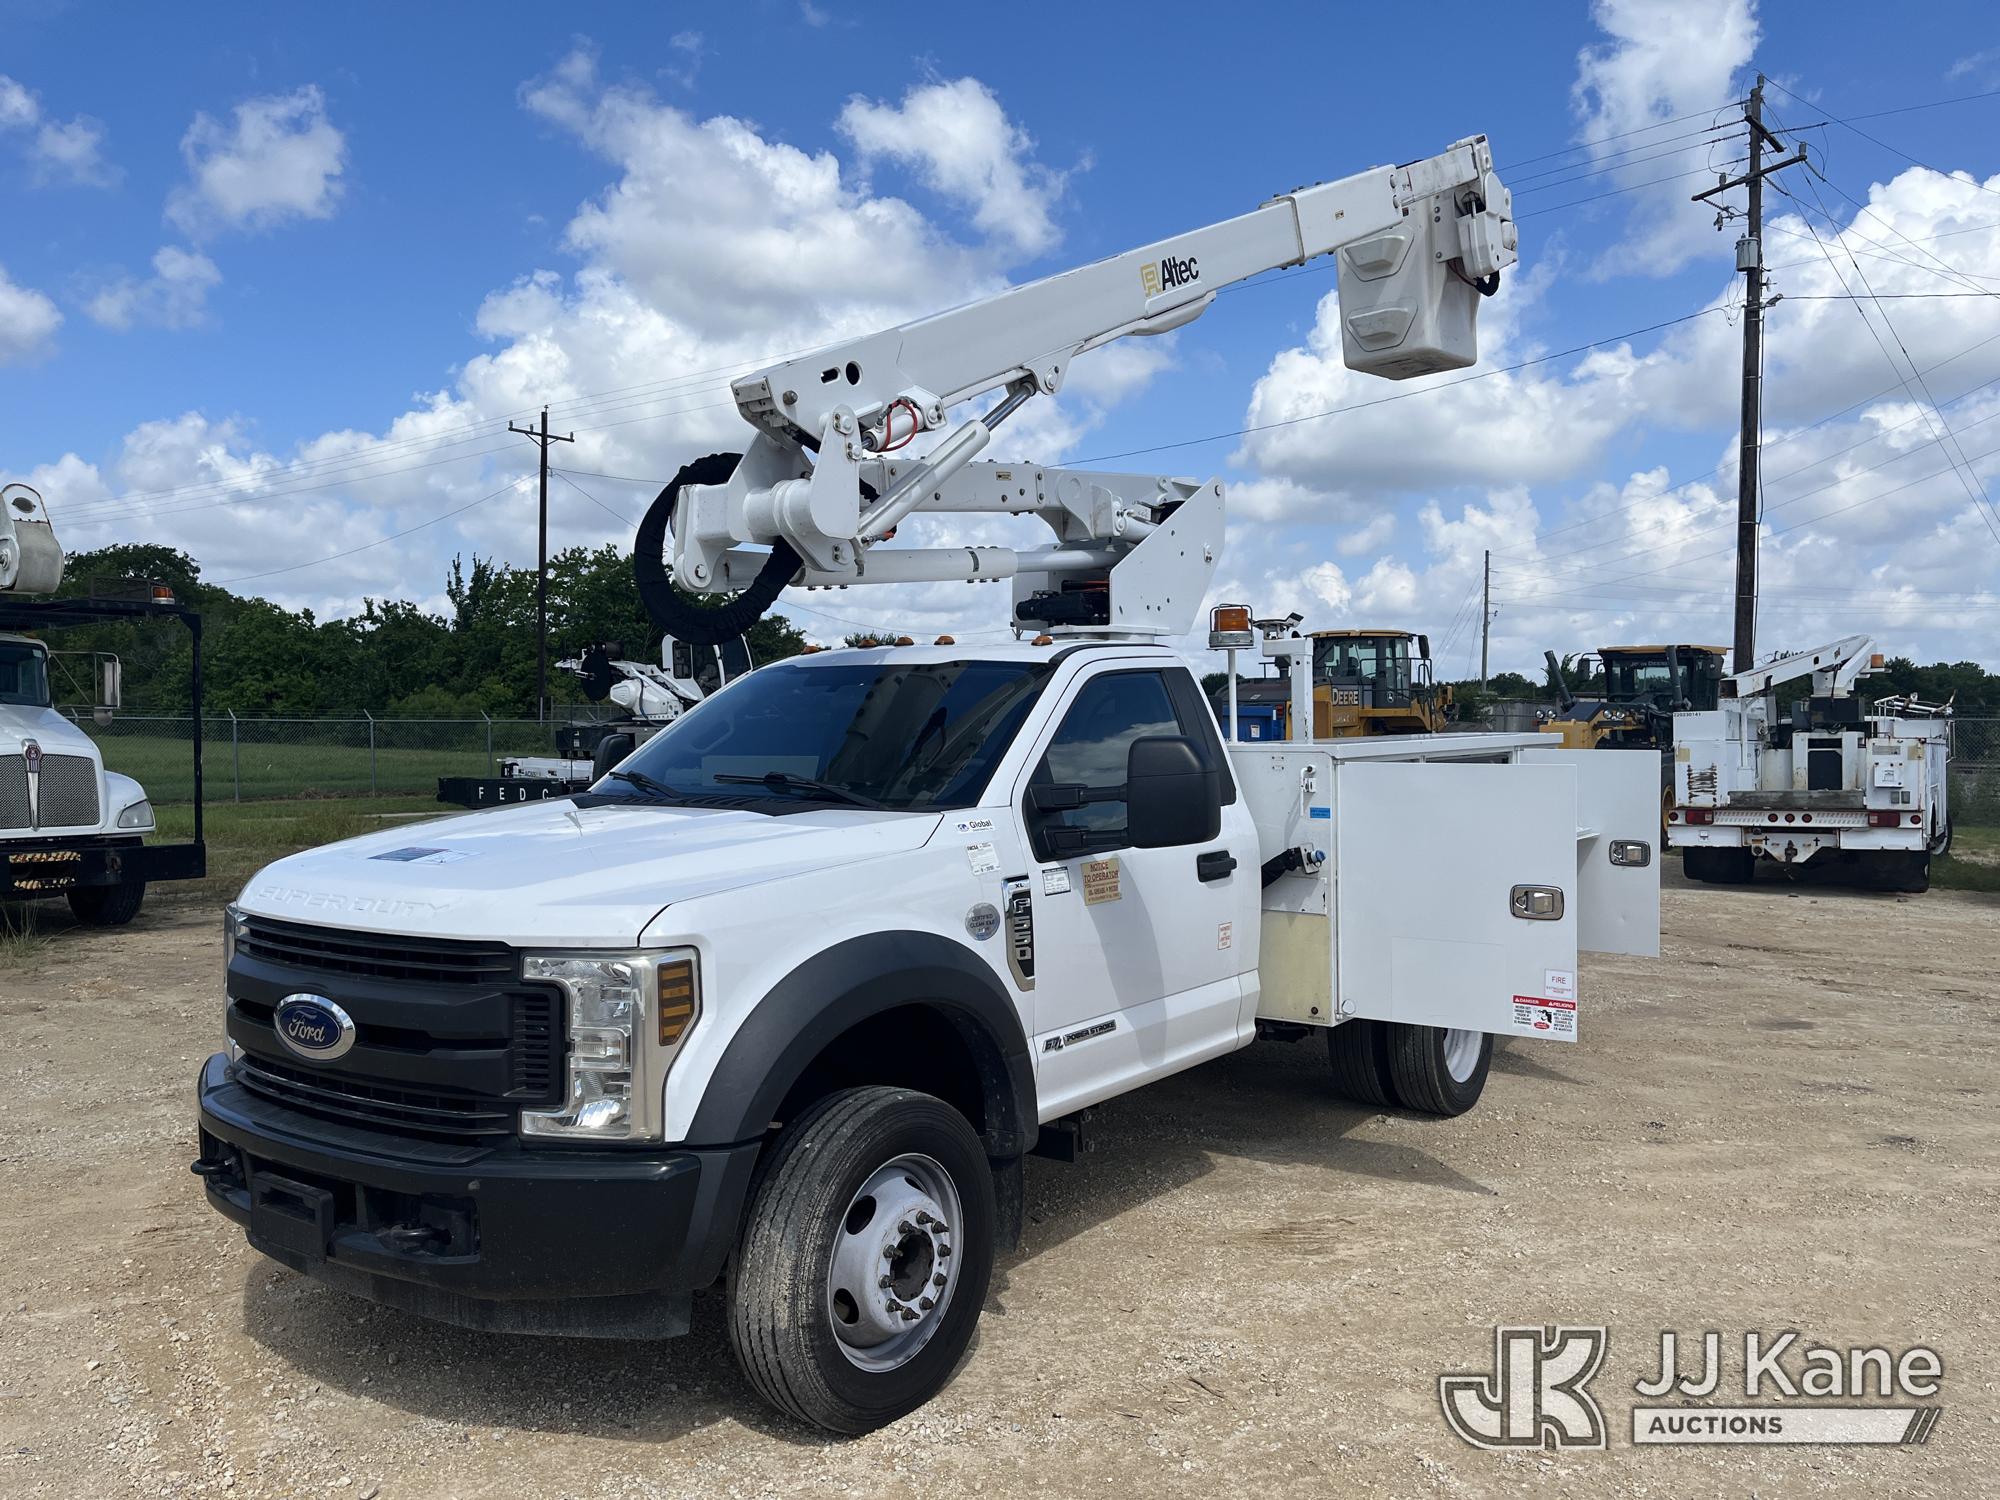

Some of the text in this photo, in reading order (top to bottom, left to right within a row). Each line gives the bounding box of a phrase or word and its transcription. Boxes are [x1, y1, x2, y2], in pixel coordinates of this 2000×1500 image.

[1161, 256, 1199, 291] Altec
[1332, 688, 1359, 705] DEERE
[1090, 861, 1109, 872] NOTICE
[1084, 870, 1119, 883] TO OPERATOR
[258, 886, 451, 917] SUPER DUTY
[1551, 976, 1567, 985] FIRE
[288, 1010, 326, 1042] Ford
[1065, 1029, 1090, 1042] POWER
[1090, 1020, 1116, 1035] STROKE
